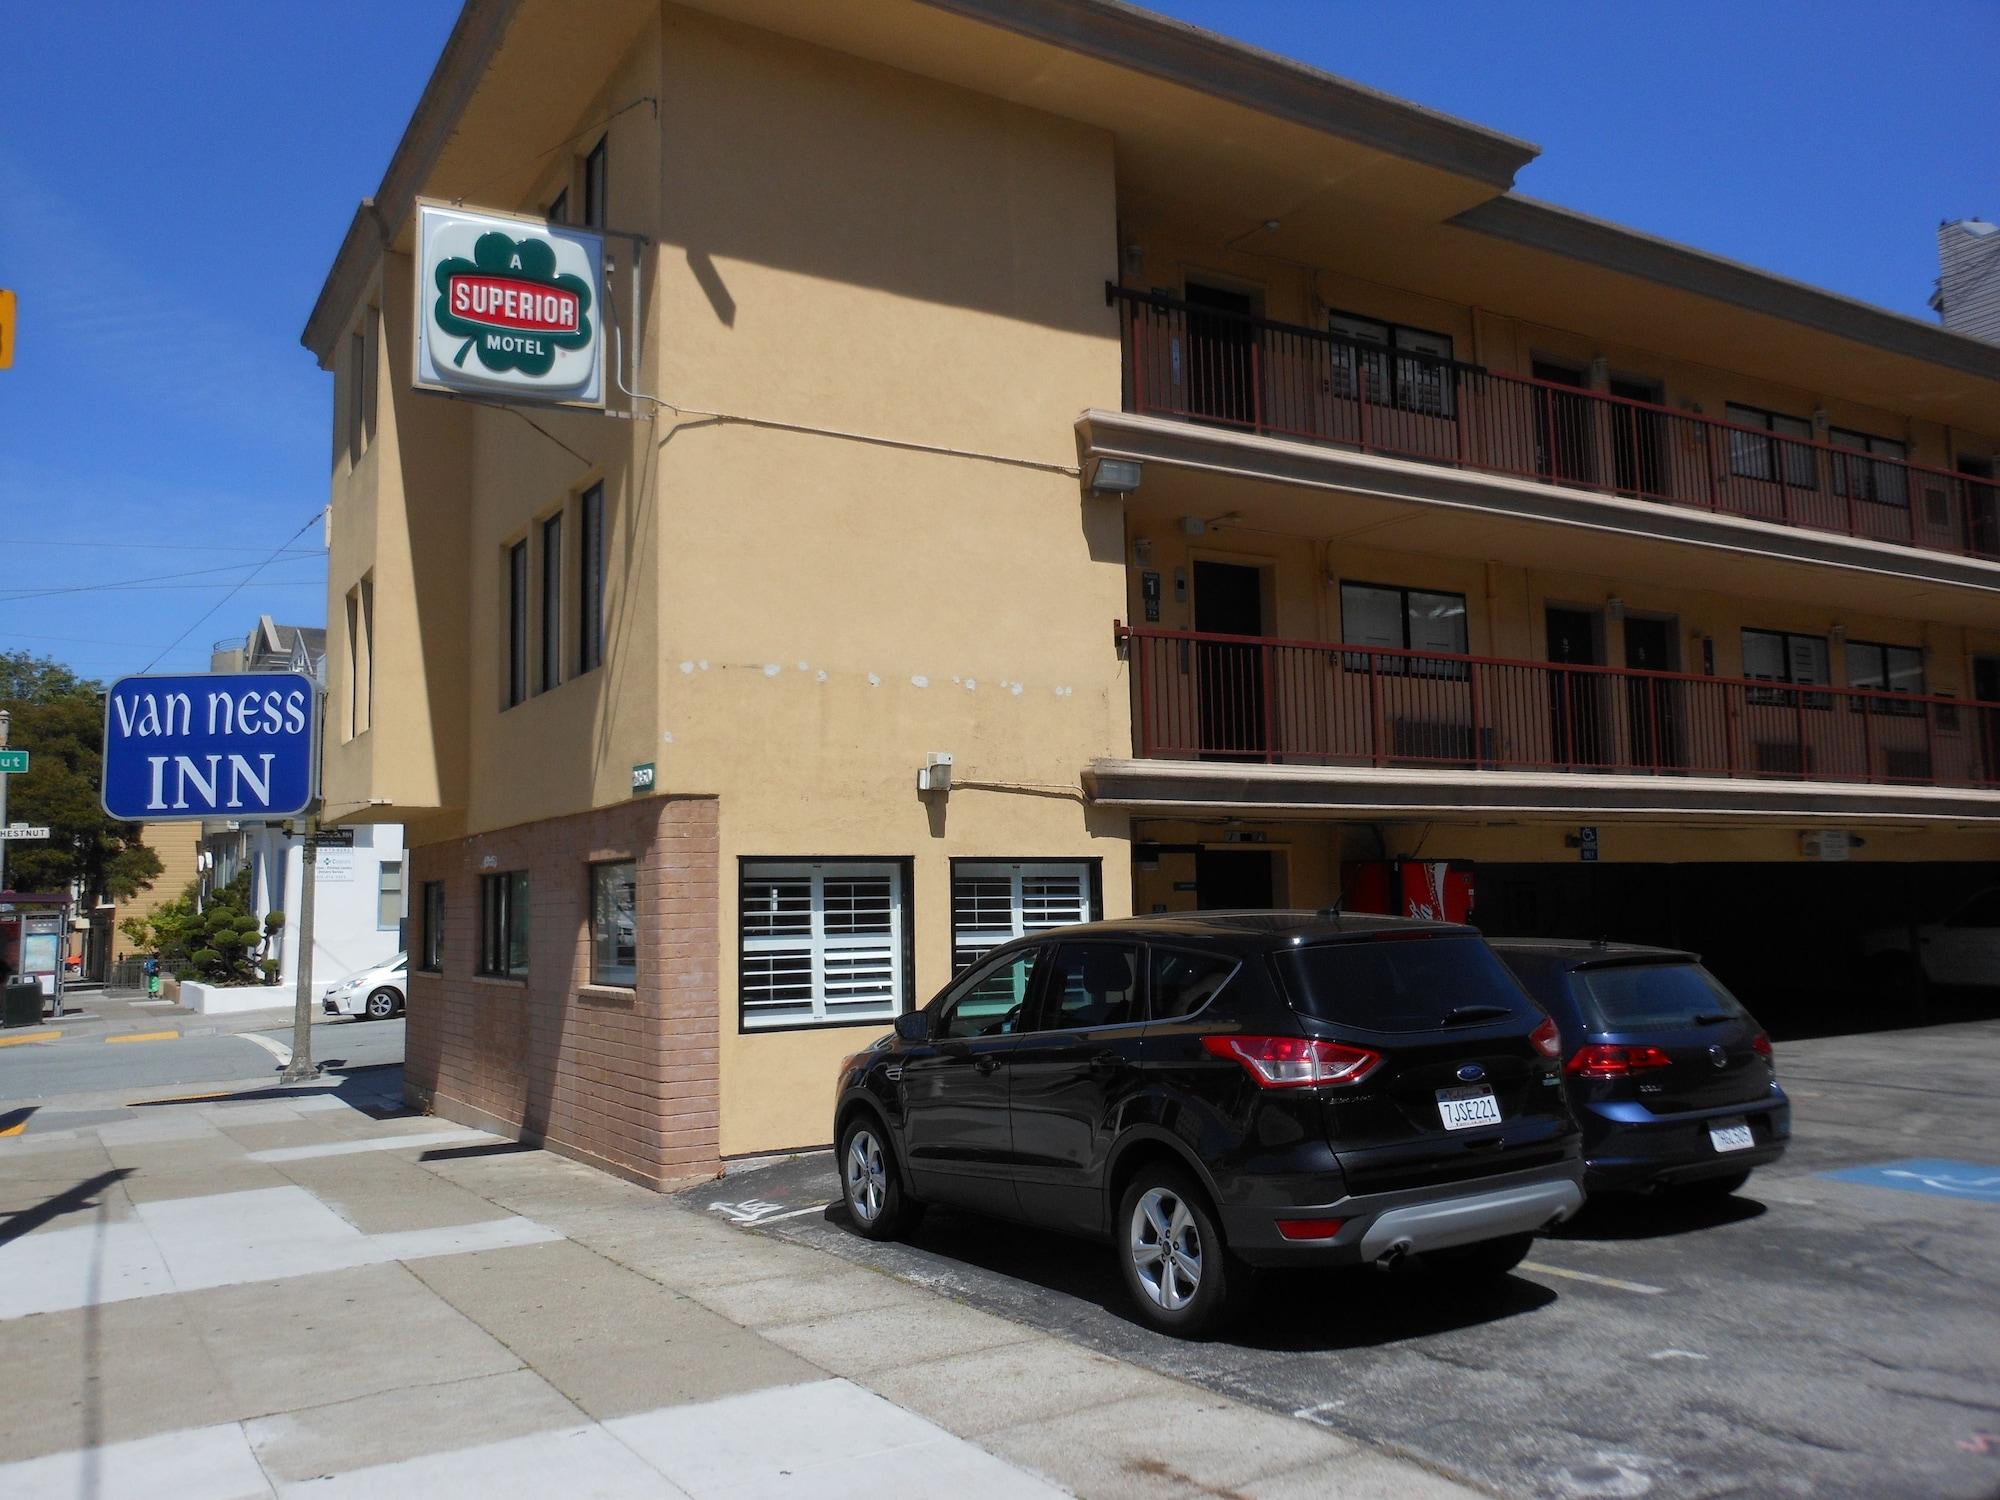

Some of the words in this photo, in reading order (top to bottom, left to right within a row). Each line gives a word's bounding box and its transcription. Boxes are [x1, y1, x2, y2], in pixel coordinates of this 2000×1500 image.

[509, 254, 522, 270] A
[455, 282, 574, 326] SUPERIOR
[486, 334, 545, 356] MOTEL
[146, 753, 276, 810] INN
[1443, 1099, 1497, 1123] 7JSE221
